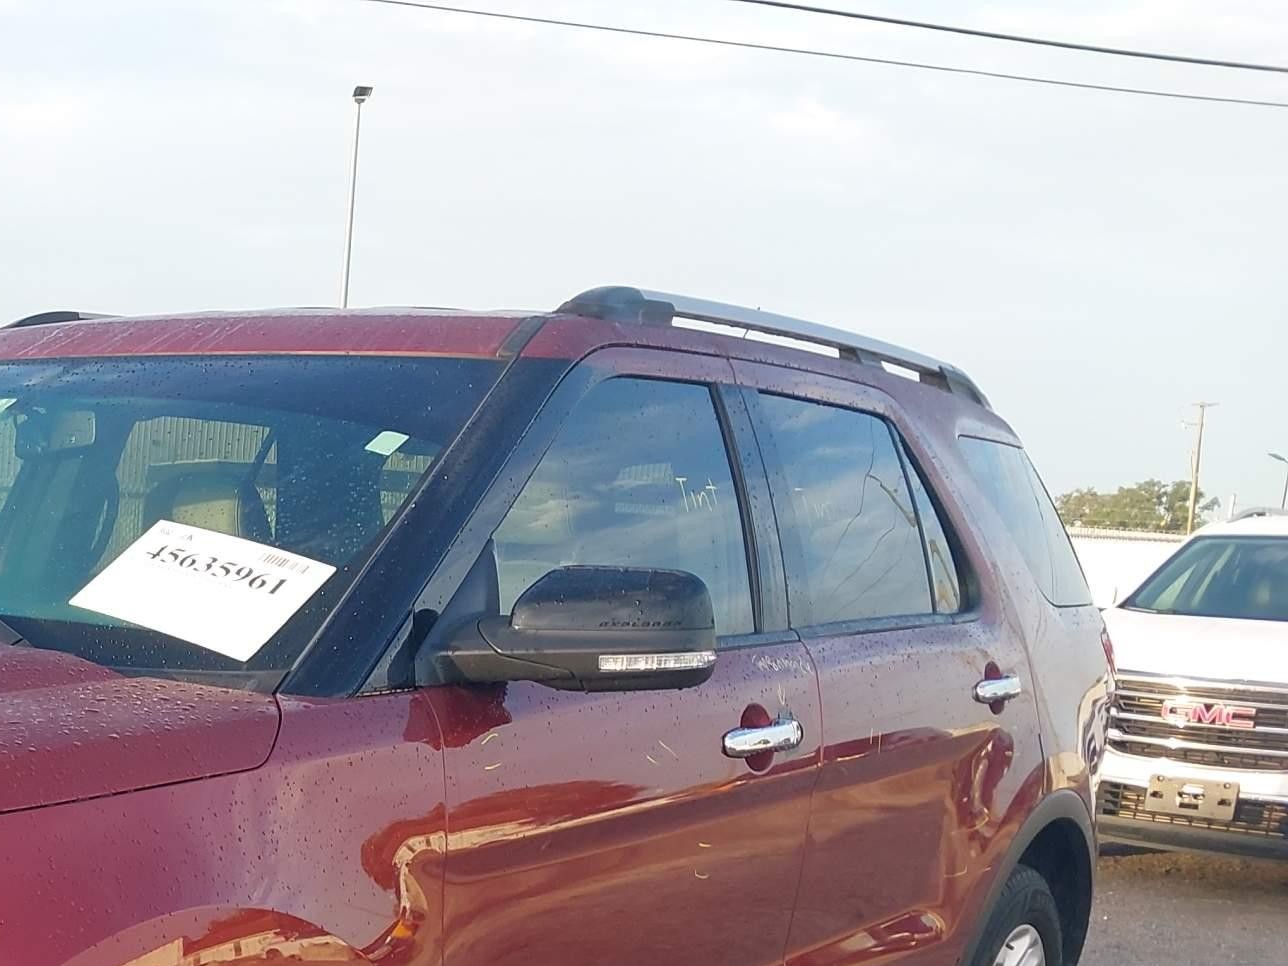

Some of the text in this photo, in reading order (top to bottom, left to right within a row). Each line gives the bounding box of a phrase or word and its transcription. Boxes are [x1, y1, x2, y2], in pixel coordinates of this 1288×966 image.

[675, 477, 718, 512] Tint
[147, 545, 287, 594] 45635961
[1161, 700, 1256, 728] GMC
